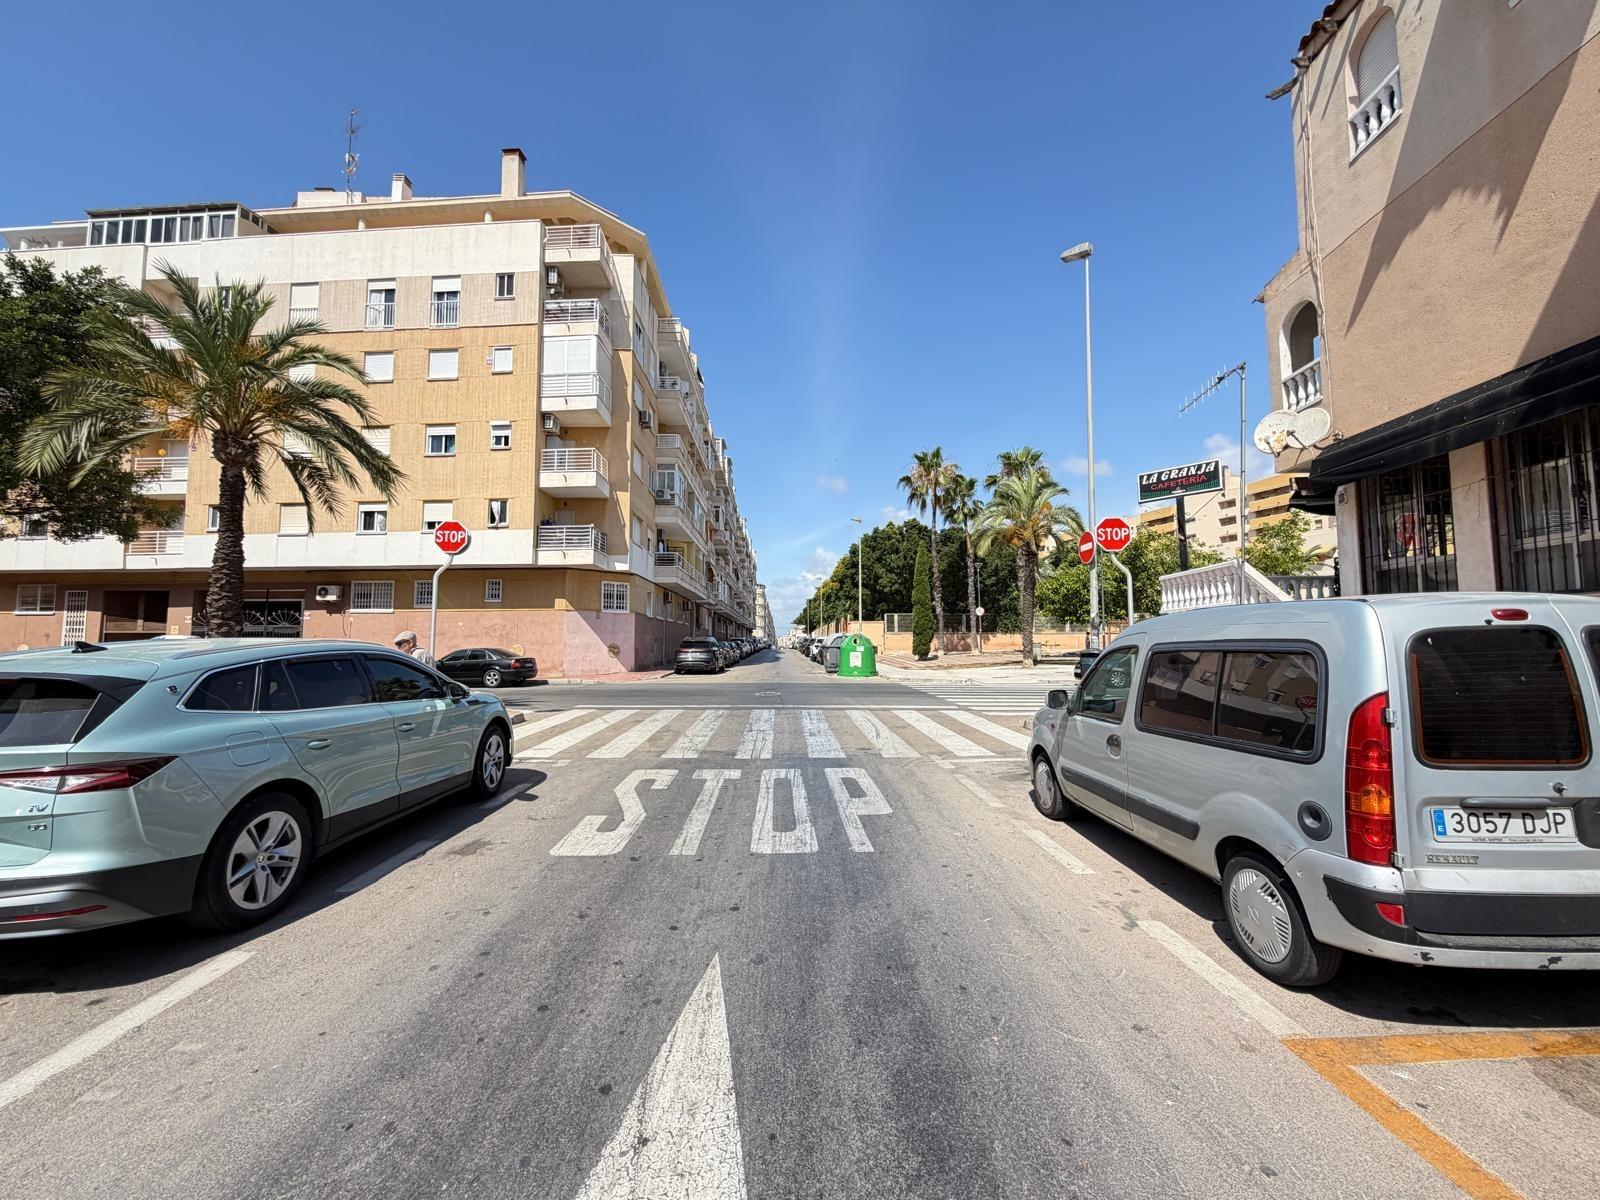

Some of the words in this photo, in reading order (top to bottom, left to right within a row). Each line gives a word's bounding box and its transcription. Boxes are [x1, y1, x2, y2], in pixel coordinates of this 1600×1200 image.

[1142, 473, 1158, 485] LA
[1161, 461, 1216, 481] GRANJA
[435, 530, 466, 543] STOP
[1097, 527, 1129, 541] STOP
[549, 768, 893, 856] STOP
[1450, 812, 1513, 835] 3057
[1521, 812, 1567, 835] DJP
